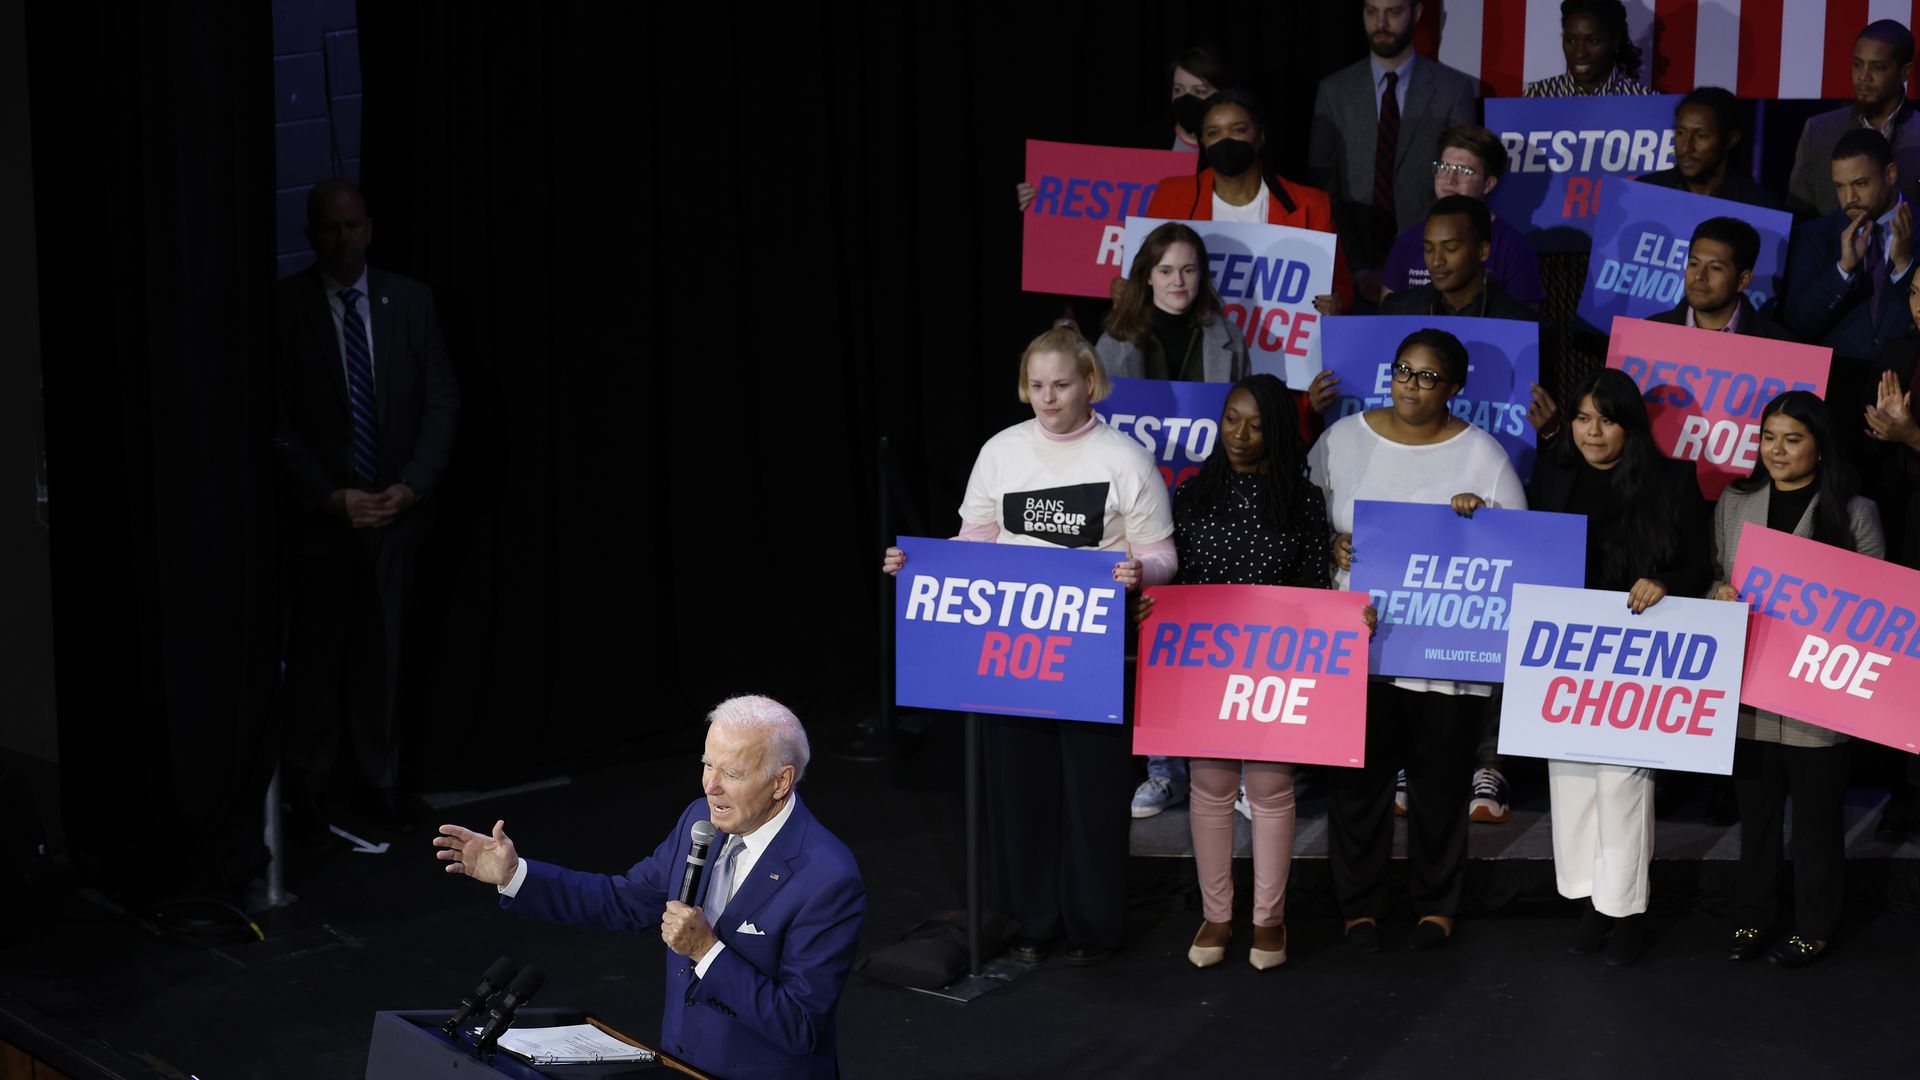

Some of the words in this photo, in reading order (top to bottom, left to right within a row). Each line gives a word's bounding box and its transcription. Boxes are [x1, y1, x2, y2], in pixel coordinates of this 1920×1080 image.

[1033, 175, 1156, 221] REST
[1632, 231, 1691, 270] ELE
[1671, 414, 1762, 469] ROE
[1023, 509, 1053, 523] OFF
[1052, 512, 1087, 526] OUR
[1023, 521, 1081, 536] BODIES
[1025, 497, 1065, 512] BANS
[1402, 553, 1514, 593] ELECT
[904, 574, 1116, 634] RESTORE
[1369, 588, 1513, 632] DEMOCR
[976, 630, 1073, 682] ROE
[1147, 622, 1359, 676] RESTORE
[1424, 648, 1502, 664] IWILLVOTE.COM
[1520, 620, 1718, 681] DEFEND
[1788, 633, 1893, 700] ROE
[1218, 674, 1317, 725] ROE
[1541, 676, 1726, 737] CHOICE
